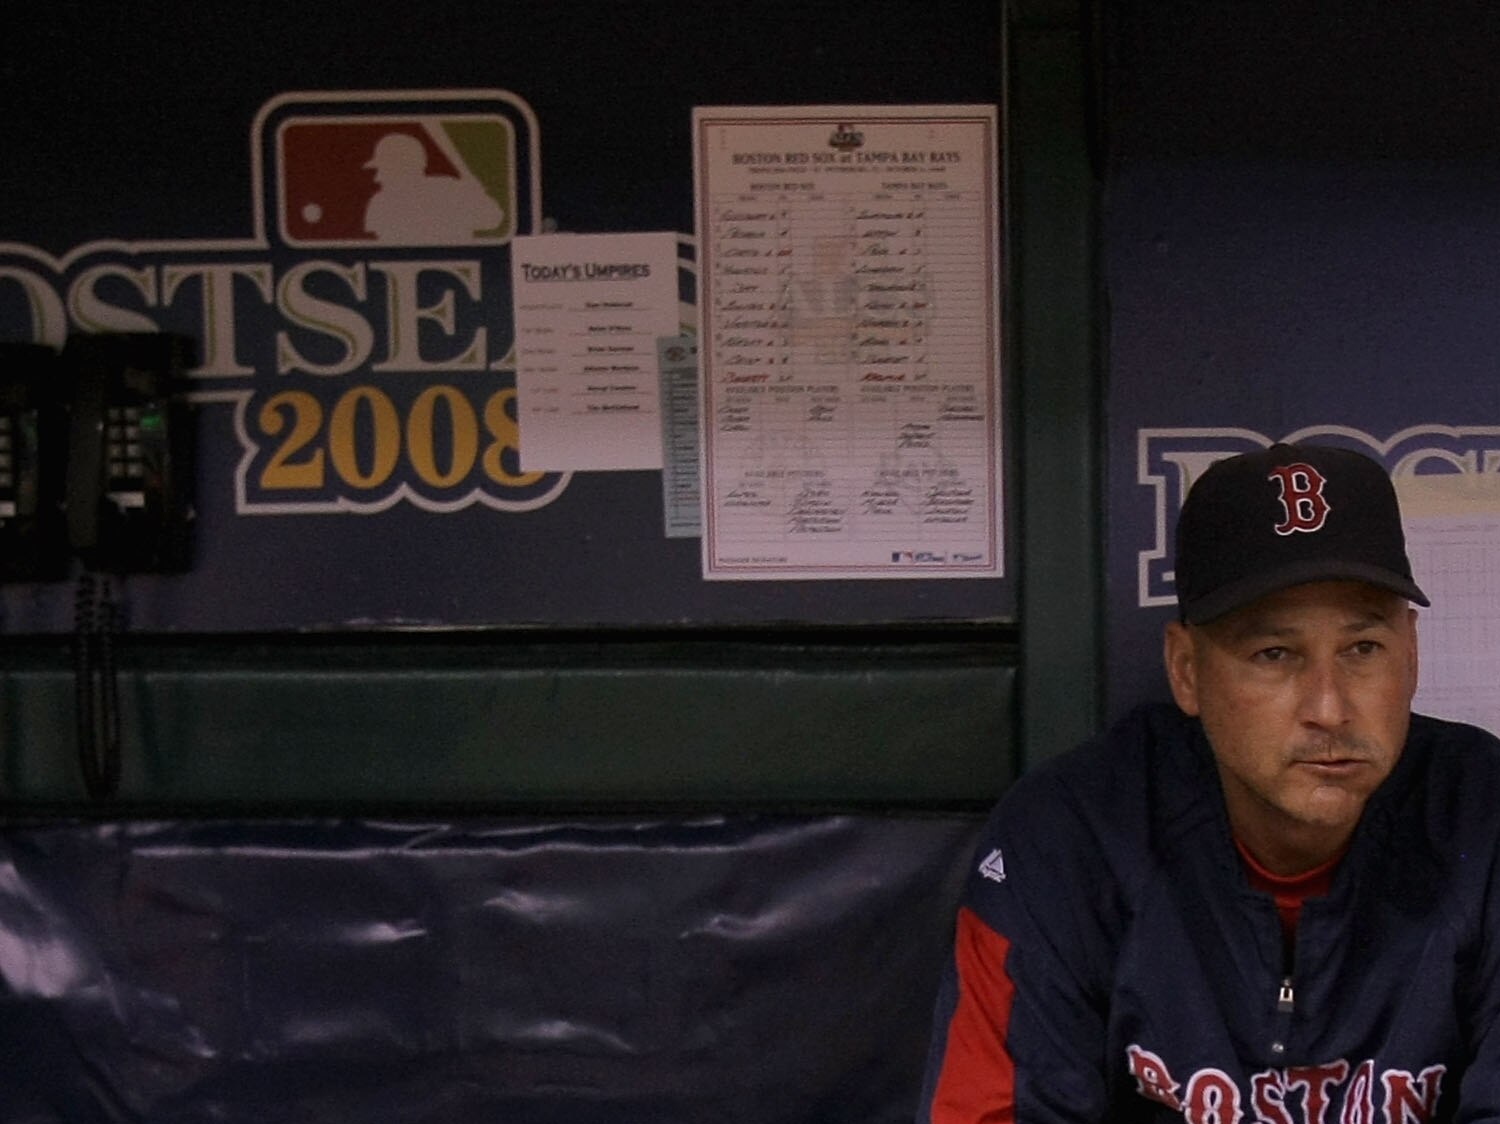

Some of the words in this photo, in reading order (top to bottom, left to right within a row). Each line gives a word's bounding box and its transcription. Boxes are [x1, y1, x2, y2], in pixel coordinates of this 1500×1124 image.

[520, 263, 582, 280] TODAY'S
[584, 262, 651, 278] UMPIRES
[1267, 462, 1332, 537] B
